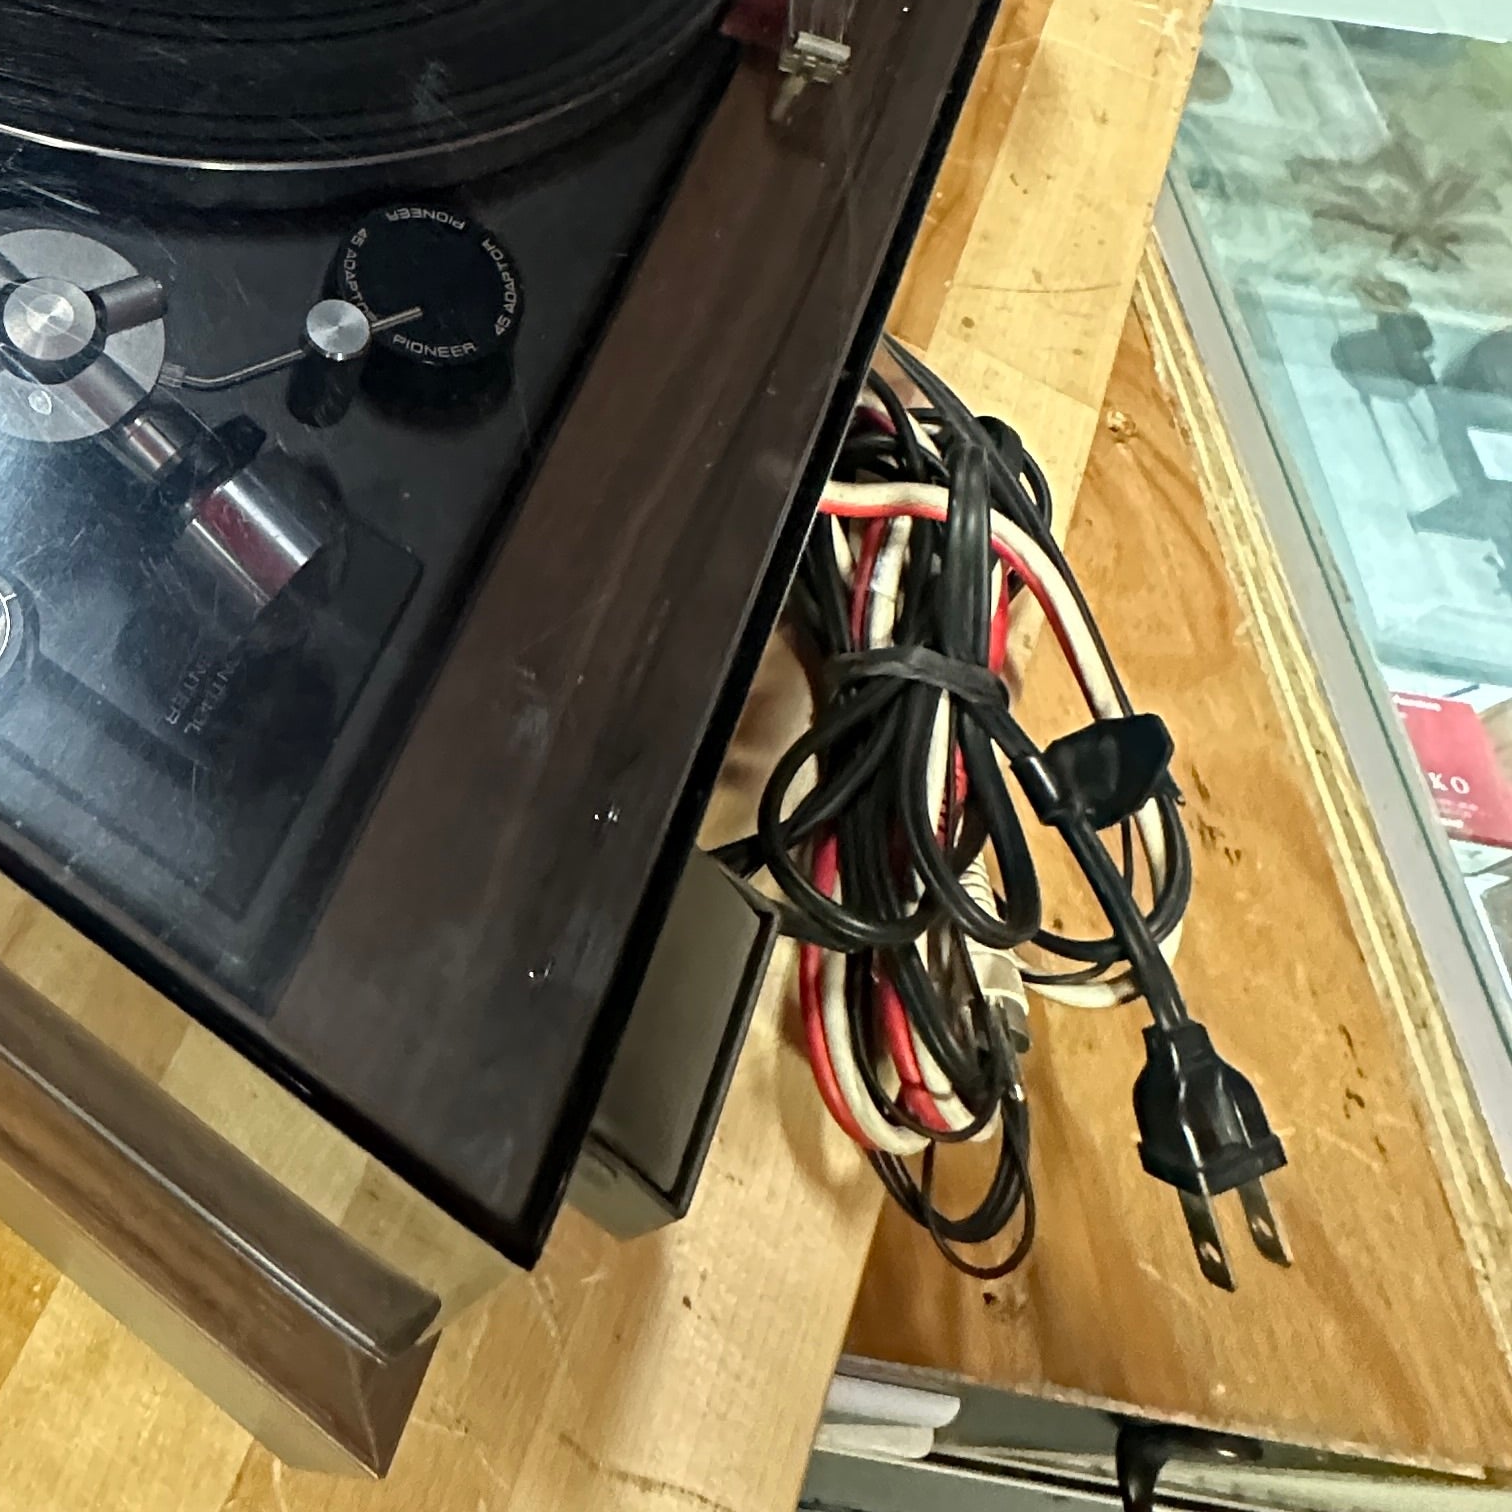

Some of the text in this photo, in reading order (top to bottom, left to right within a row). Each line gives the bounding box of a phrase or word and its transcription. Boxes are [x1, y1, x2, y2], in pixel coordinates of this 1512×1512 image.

[386, 207, 467, 231] PIONEER
[350, 227, 369, 248] 45
[481, 237, 518, 337] 45 ADAPTOR
[392, 333, 479, 359] PIONEER
